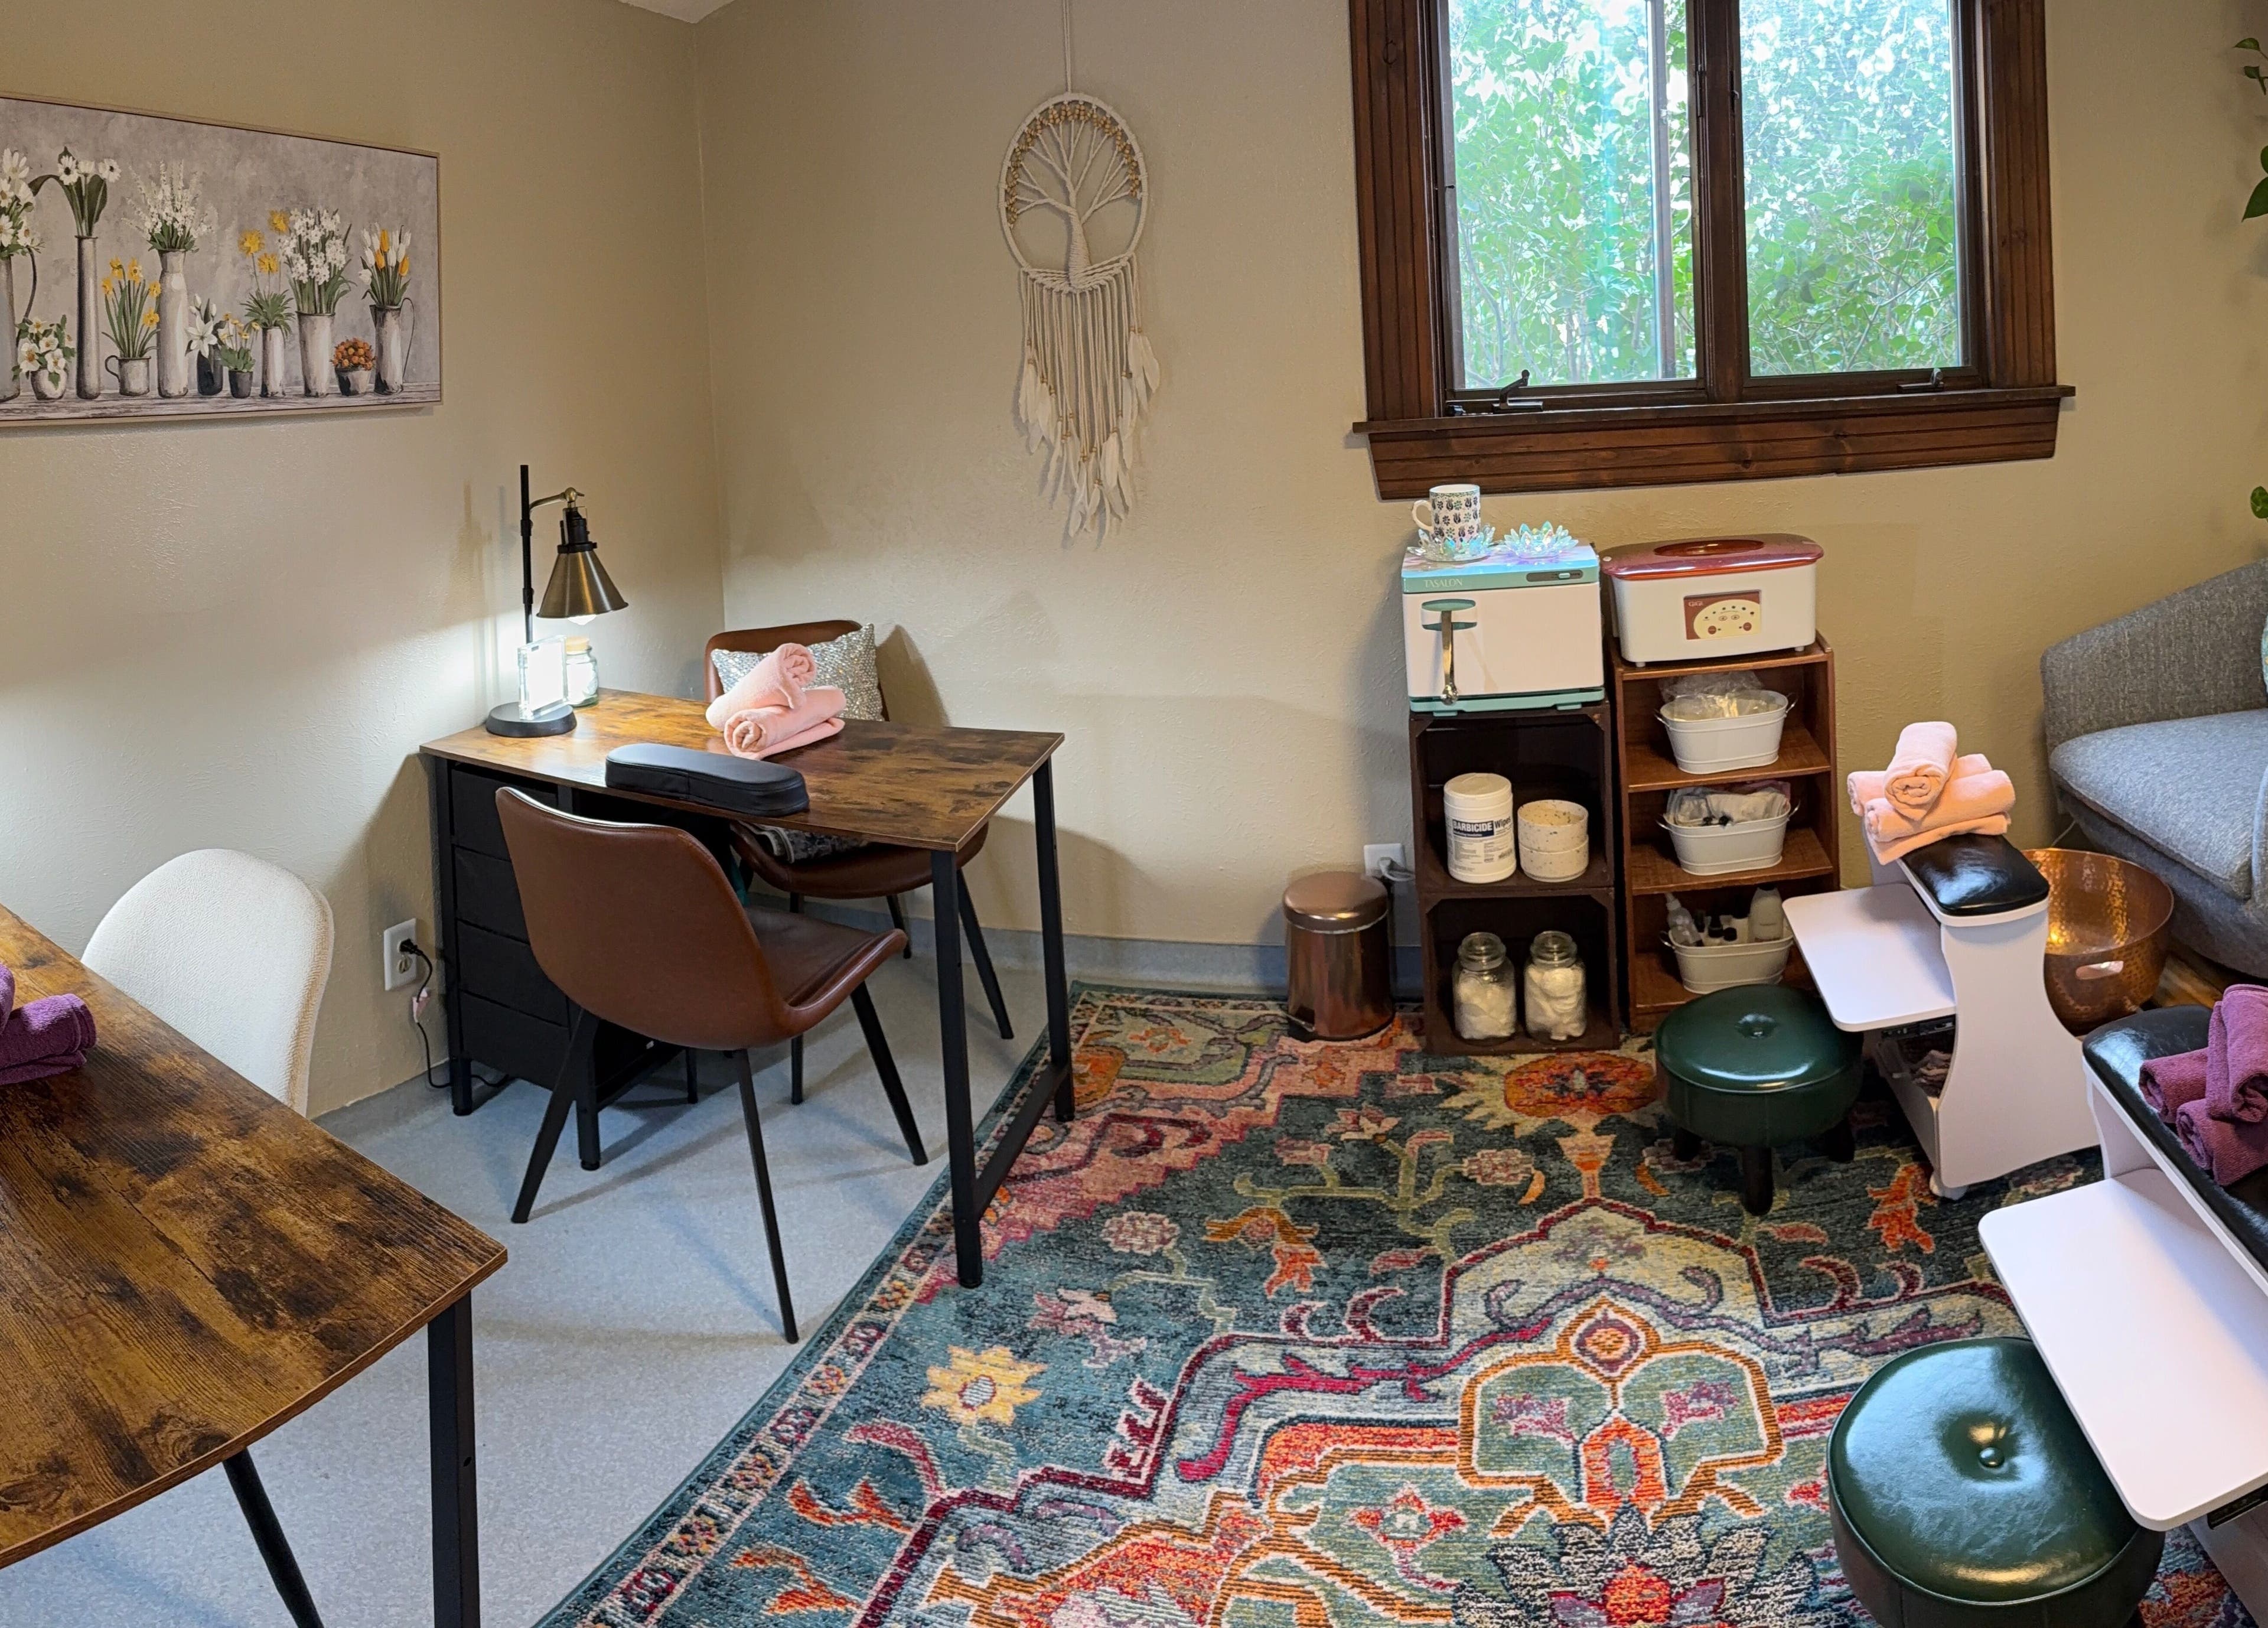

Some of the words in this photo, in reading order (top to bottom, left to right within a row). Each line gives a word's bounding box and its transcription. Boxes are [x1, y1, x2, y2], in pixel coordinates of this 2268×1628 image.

[1424, 578, 1463, 588] TASALON
[1453, 820, 1493, 832] BARBICIDE
[1494, 816, 1511, 829] Wipes
